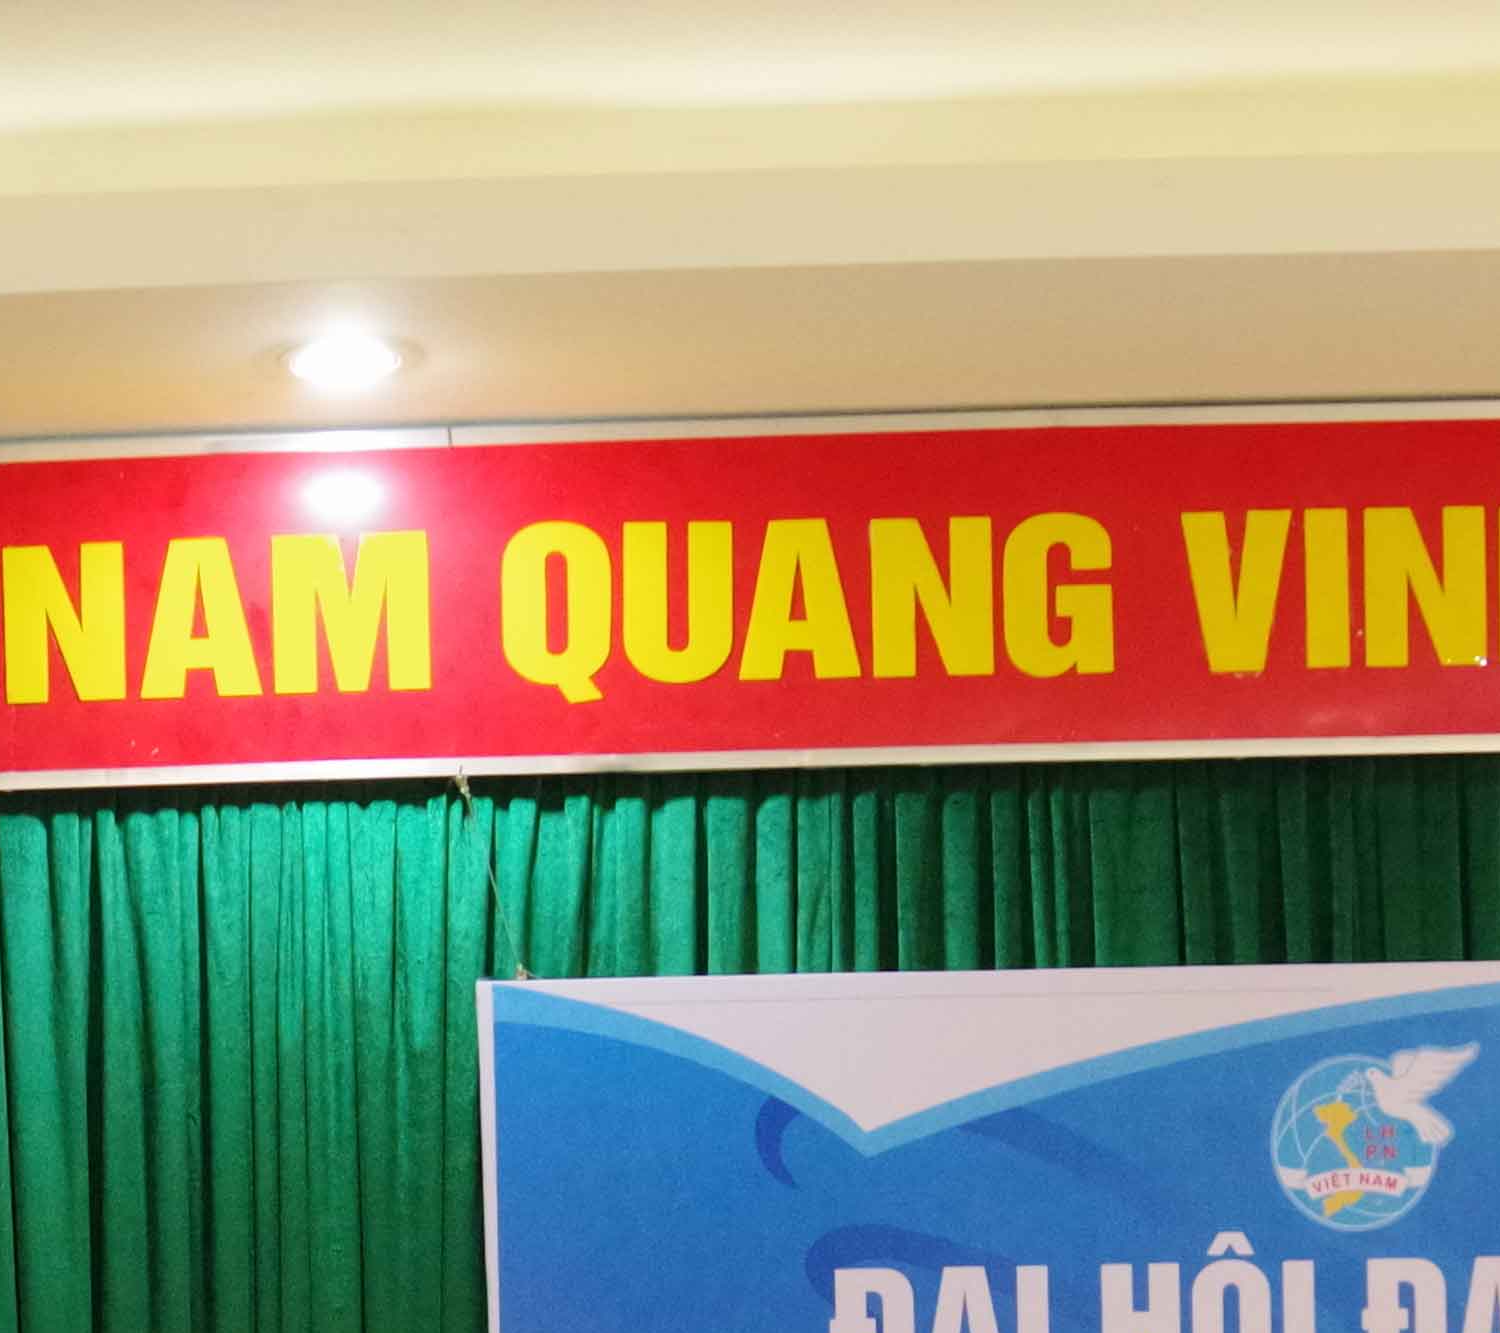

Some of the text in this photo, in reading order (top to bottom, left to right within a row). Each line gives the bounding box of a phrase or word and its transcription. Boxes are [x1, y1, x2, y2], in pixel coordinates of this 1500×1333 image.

[1, 529, 432, 704] NAM
[499, 511, 1114, 703] QUANG
[1359, 1172, 1398, 1190] NAM
